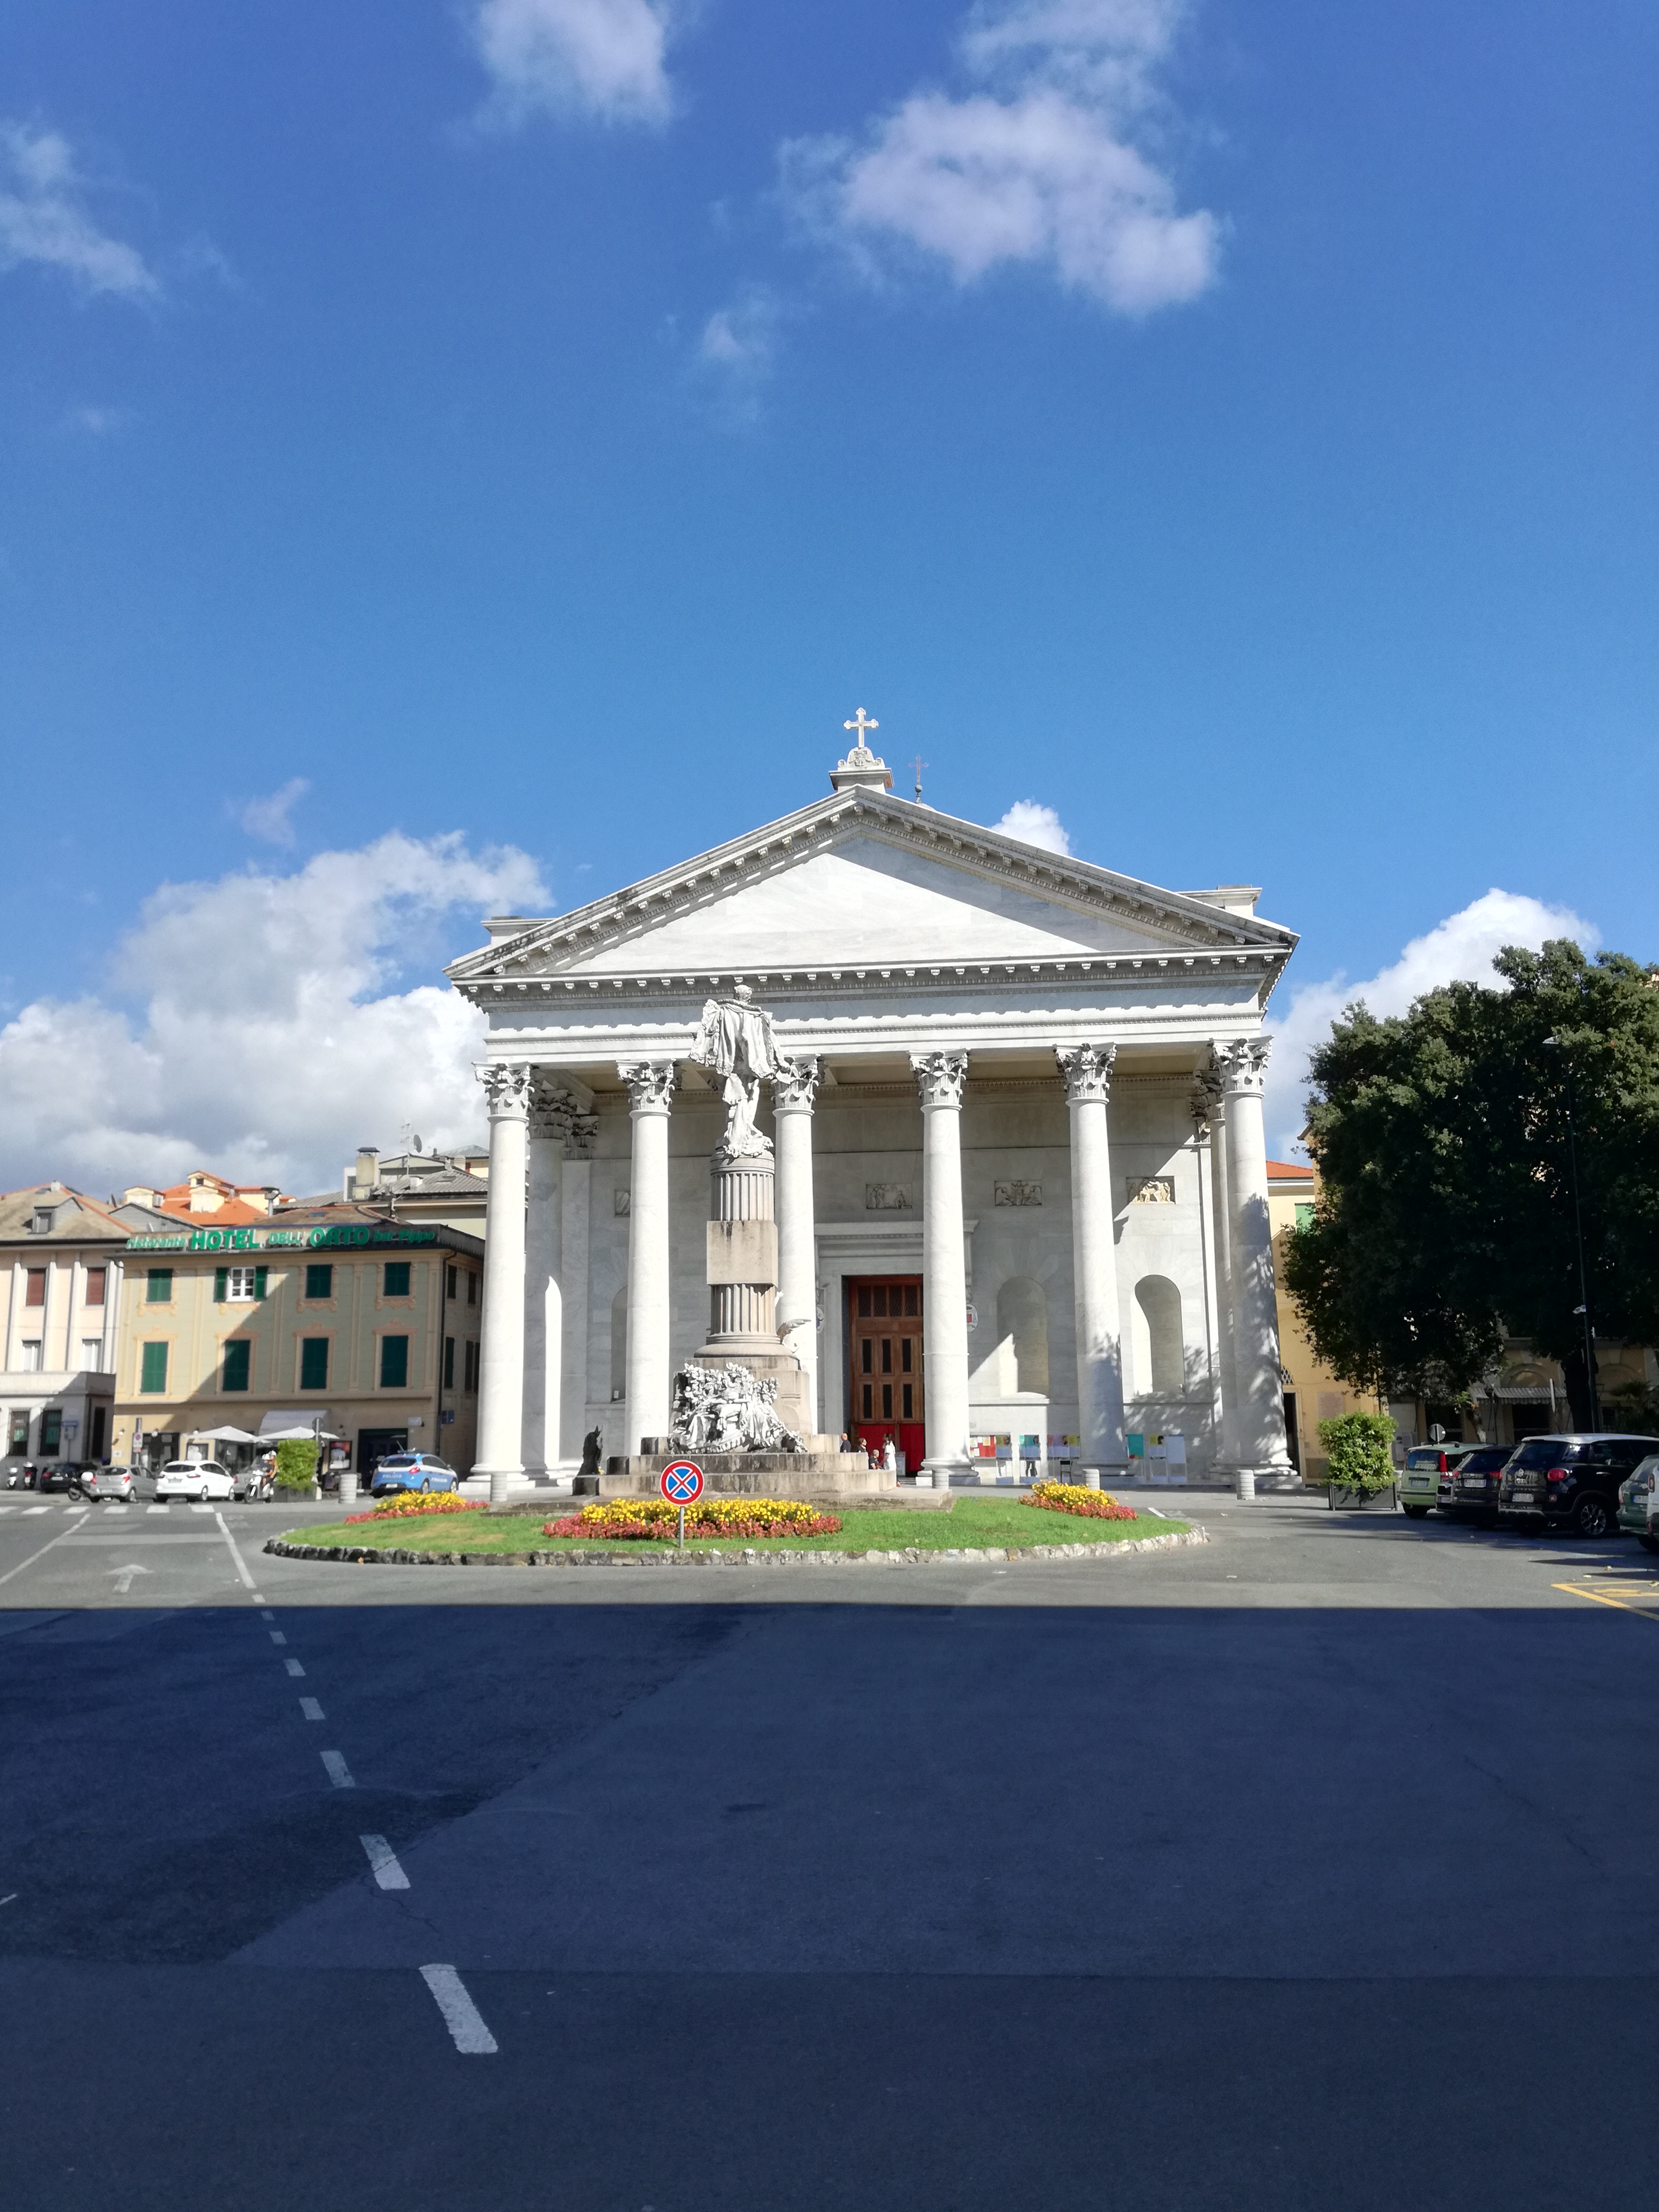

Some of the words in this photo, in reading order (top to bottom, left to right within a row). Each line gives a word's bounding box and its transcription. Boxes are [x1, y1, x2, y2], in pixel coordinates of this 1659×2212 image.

[126, 1237, 185, 1249] ristorante
[191, 1229, 260, 1250] HOTEL
[310, 1227, 369, 1246] ORTO
[373, 1229, 395, 1241] bar
[399, 1229, 434, 1243] Pippo
